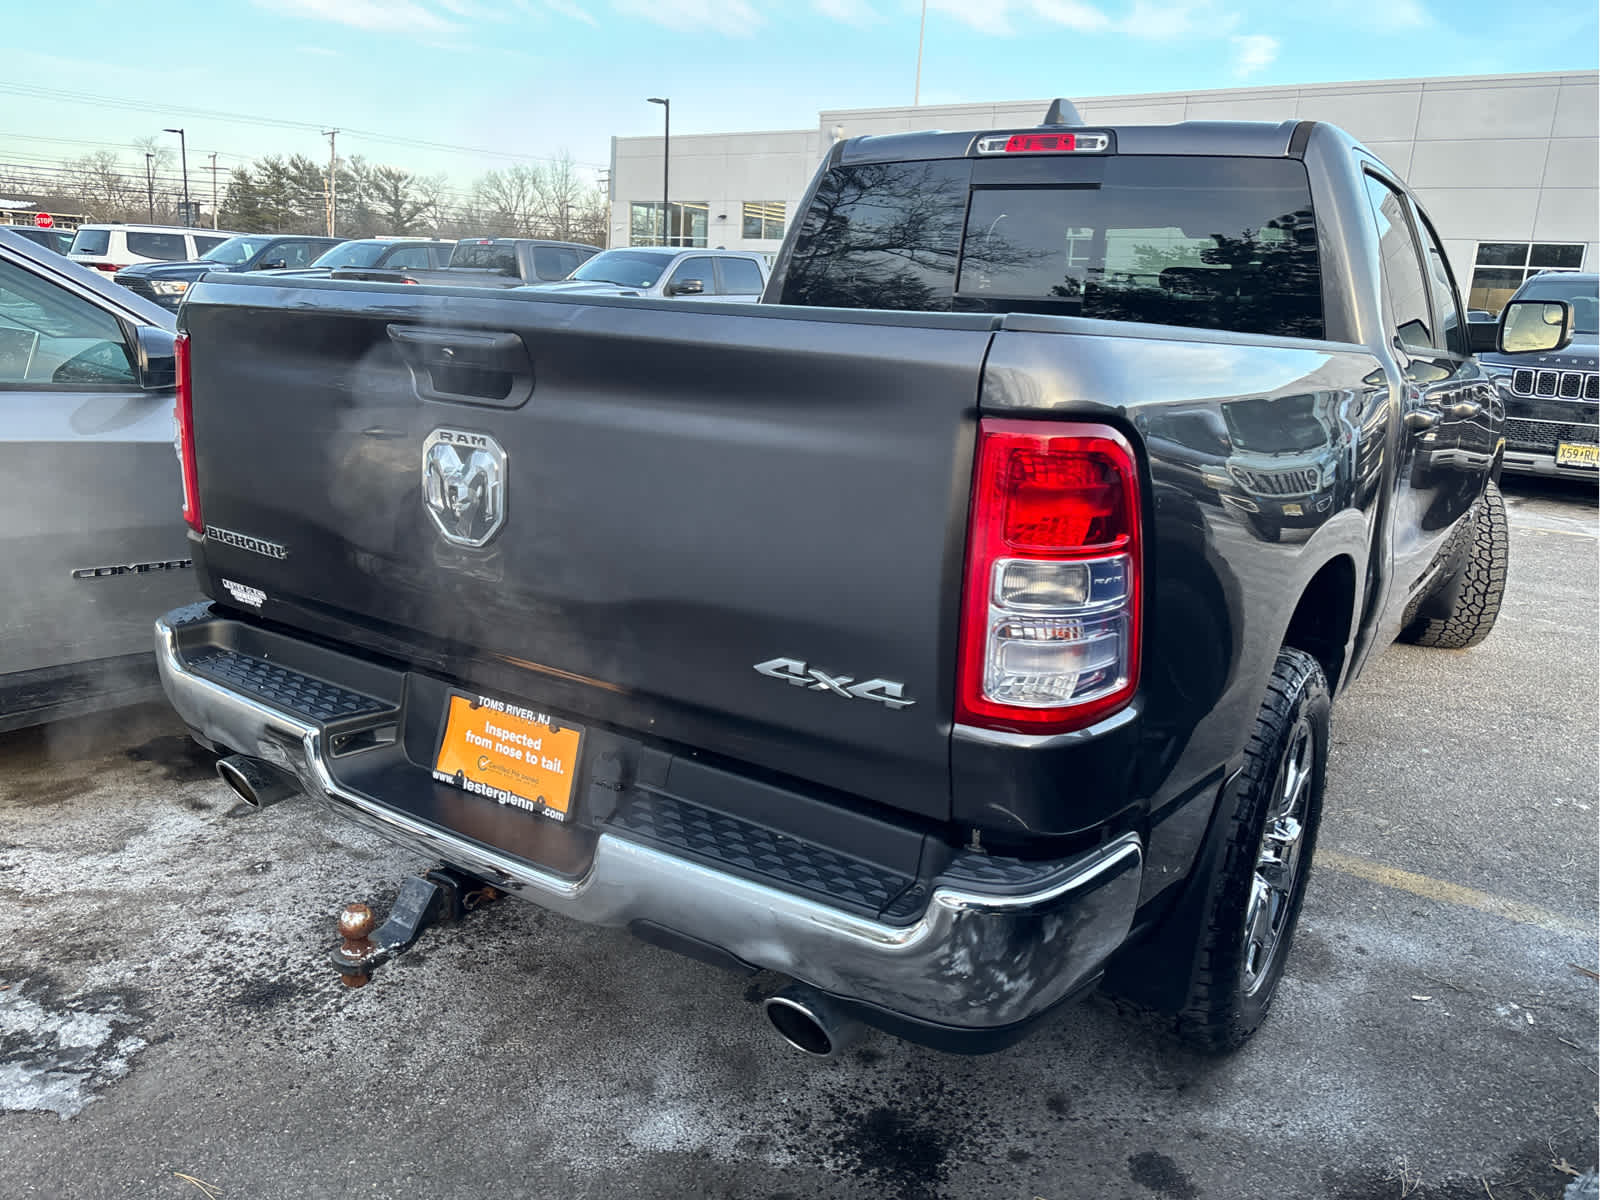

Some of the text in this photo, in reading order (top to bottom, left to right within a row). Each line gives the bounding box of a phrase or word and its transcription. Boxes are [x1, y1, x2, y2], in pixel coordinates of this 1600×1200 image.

[36, 217, 53, 225] STOP
[439, 431, 487, 446] RAM
[478, 695, 504, 712] TOMS
[538, 714, 551, 725] NJ
[485, 721, 542, 751] Inspected
[465, 730, 492, 750] from
[495, 742, 522, 760] nose
[525, 750, 538, 765] to
[540, 755, 564, 775] tail.
[462, 776, 534, 812] lesterglenn
